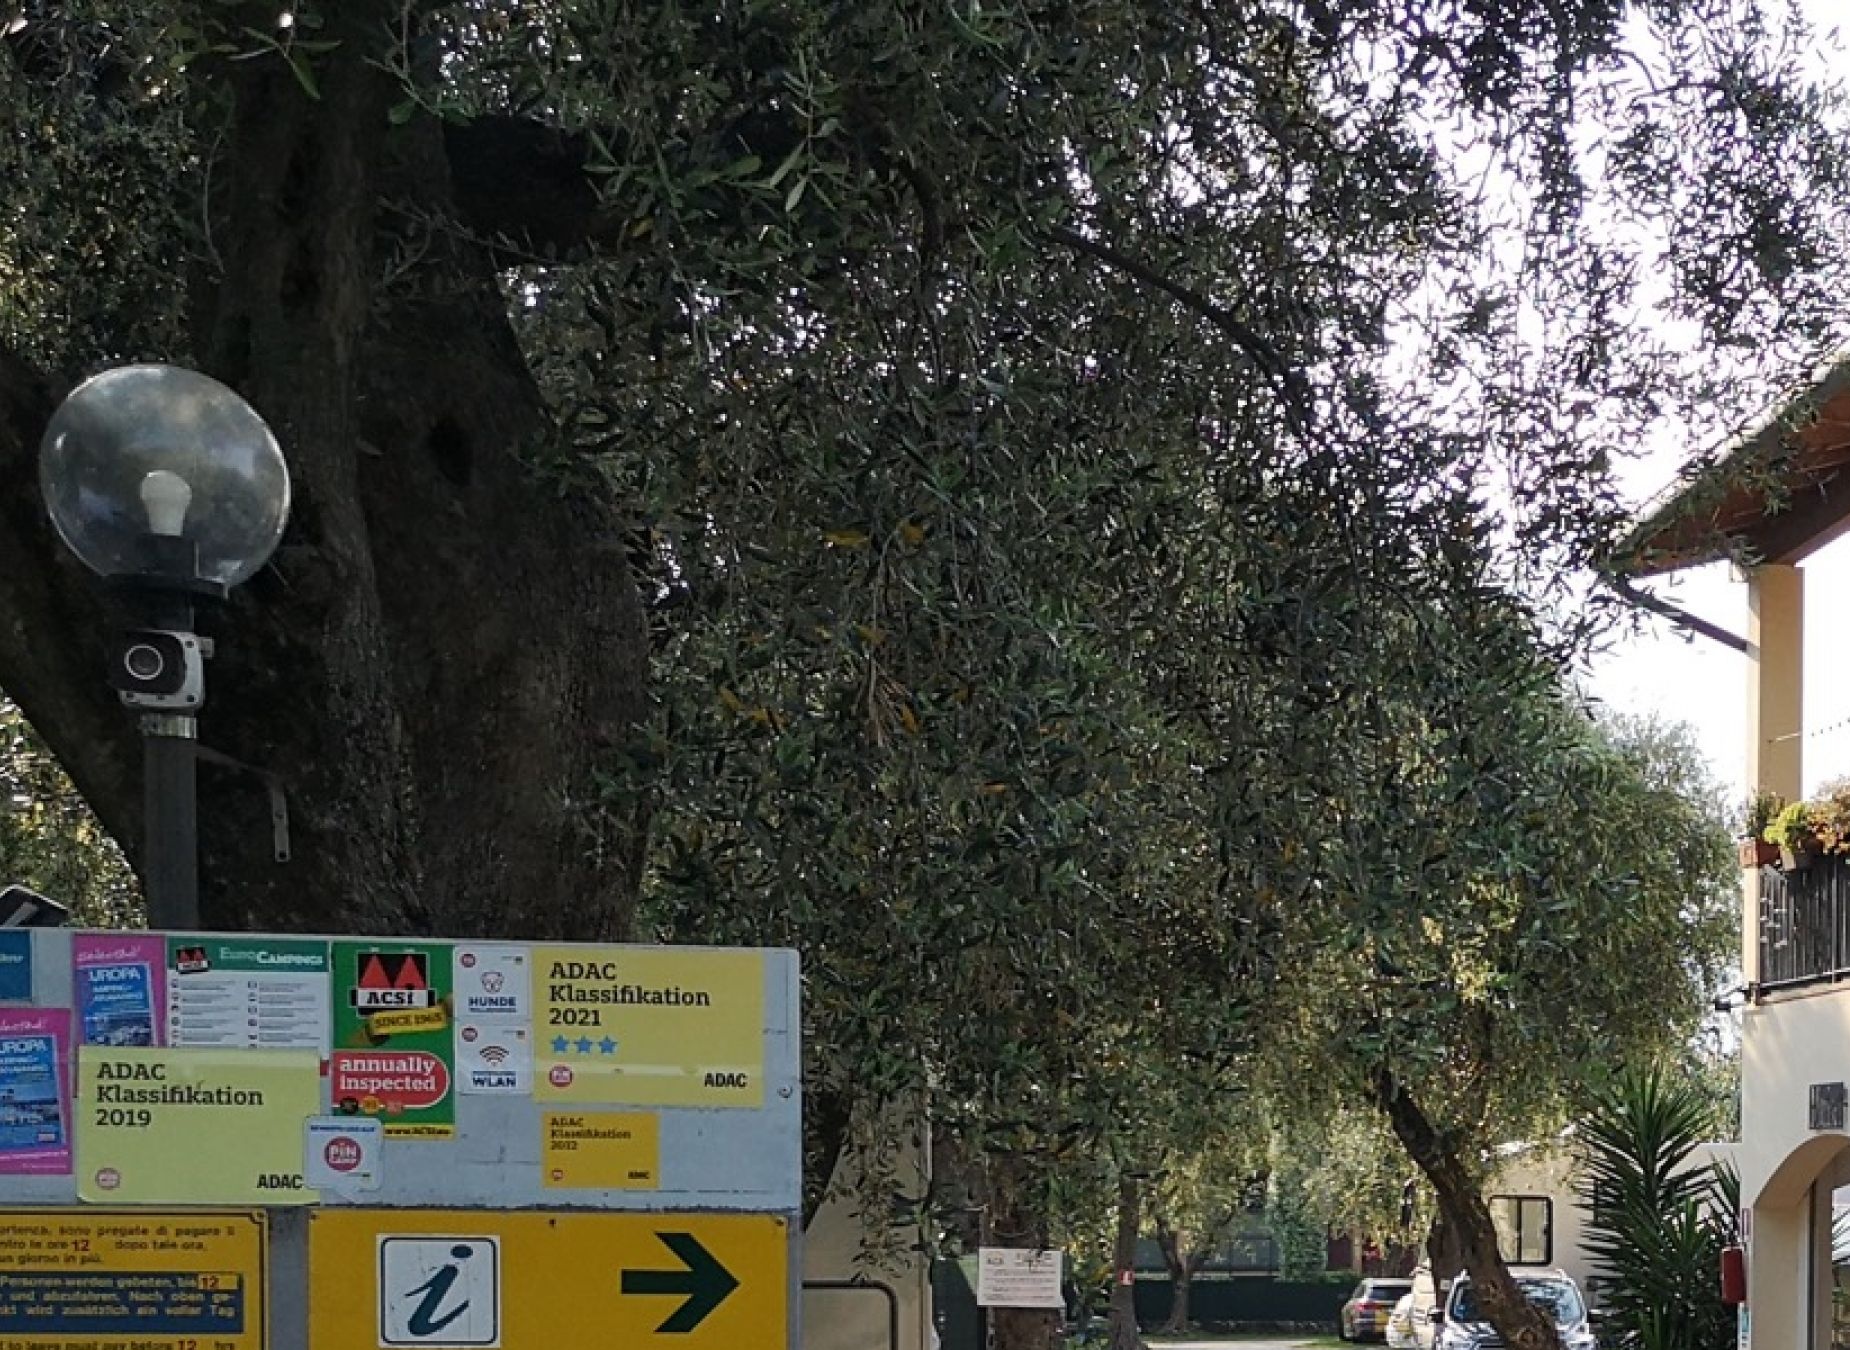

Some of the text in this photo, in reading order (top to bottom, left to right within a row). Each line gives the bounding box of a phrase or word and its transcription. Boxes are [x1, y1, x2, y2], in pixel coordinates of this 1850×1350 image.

[549, 963, 617, 980] ADAC
[366, 992, 415, 1004] ACSI
[468, 997, 516, 1006] HUNDE
[549, 984, 710, 1007] Klassifikation
[549, 1009, 601, 1027] 2021
[97, 1063, 165, 1080] ADAC
[340, 1056, 436, 1077] annually
[340, 1074, 436, 1093] inspected
[473, 1077, 516, 1087] WLAN
[704, 1072, 747, 1087] ADAC
[97, 1085, 264, 1106] Klassifikation
[96, 1108, 151, 1126] 2019
[257, 1174, 303, 1189] ADAC
[71, 1239, 91, 1252] 12
